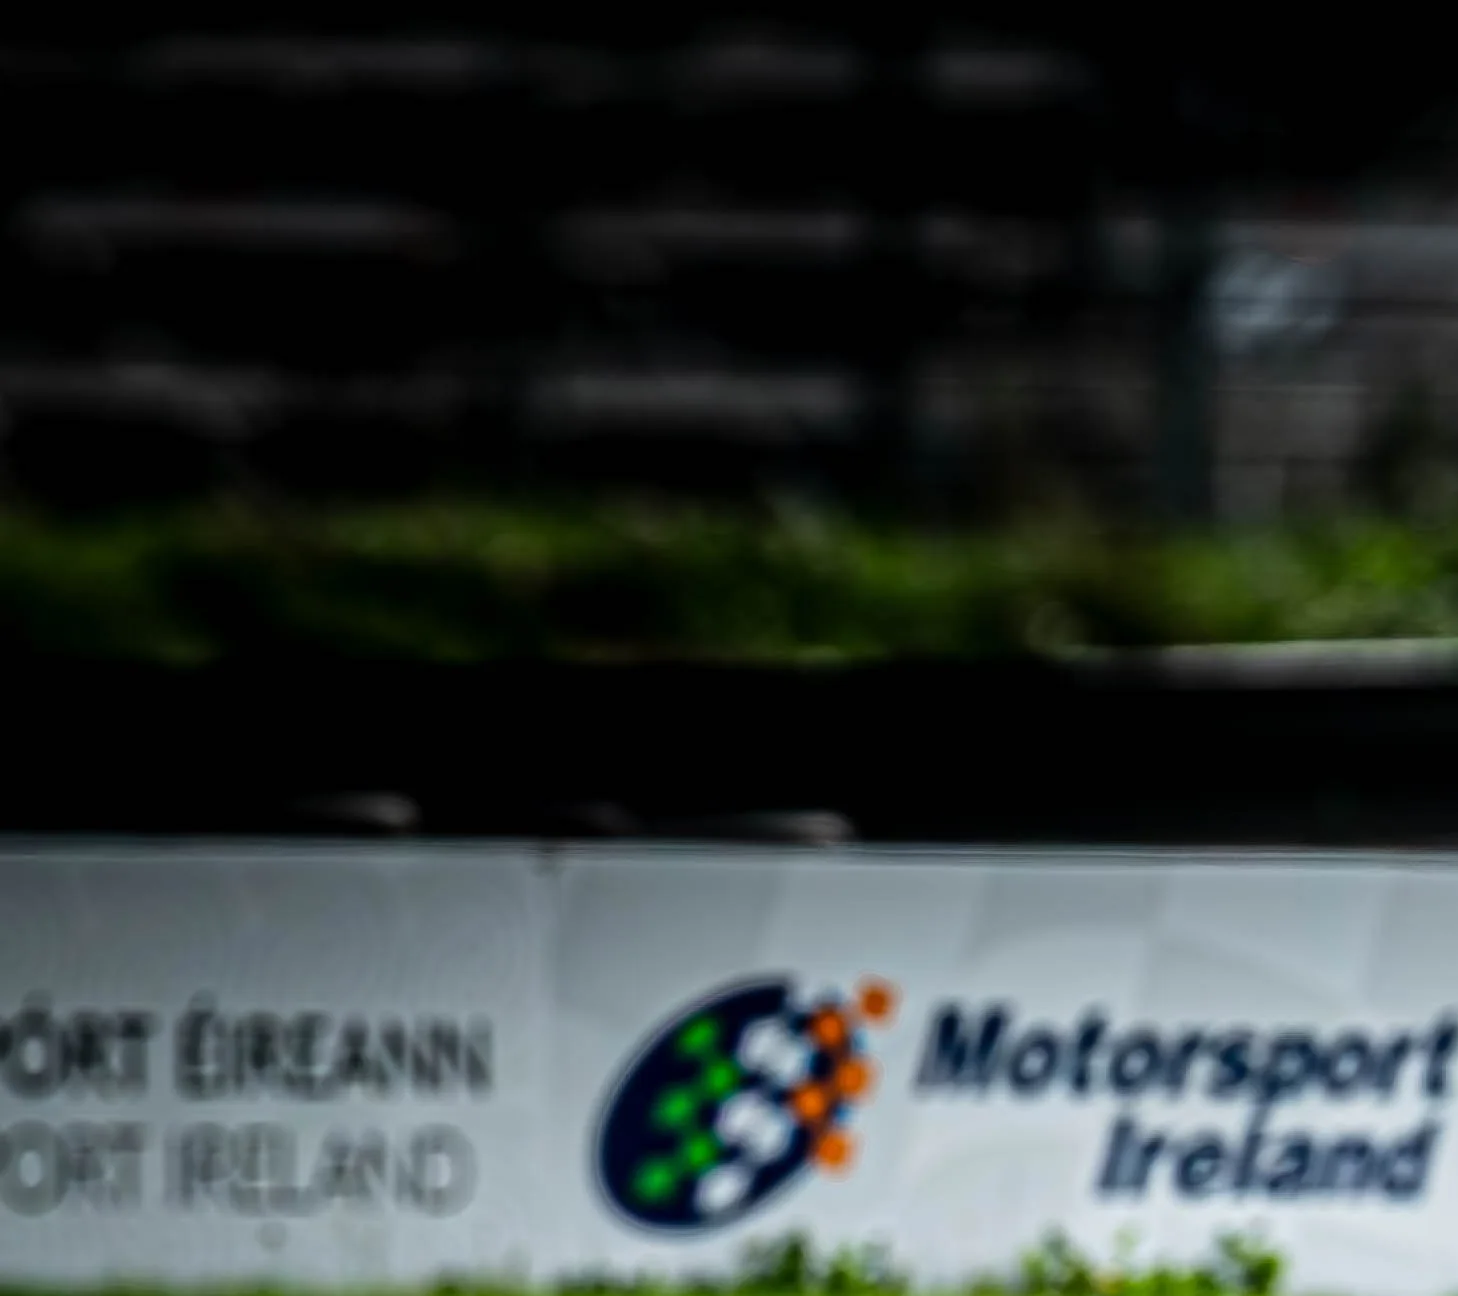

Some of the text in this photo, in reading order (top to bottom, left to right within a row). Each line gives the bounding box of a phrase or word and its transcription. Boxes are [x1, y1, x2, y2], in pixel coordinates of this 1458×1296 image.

[0, 992, 154, 1098] ÓRT
[0, 1122, 150, 1214] ORT
[1098, 1116, 1442, 1198] Ireland
